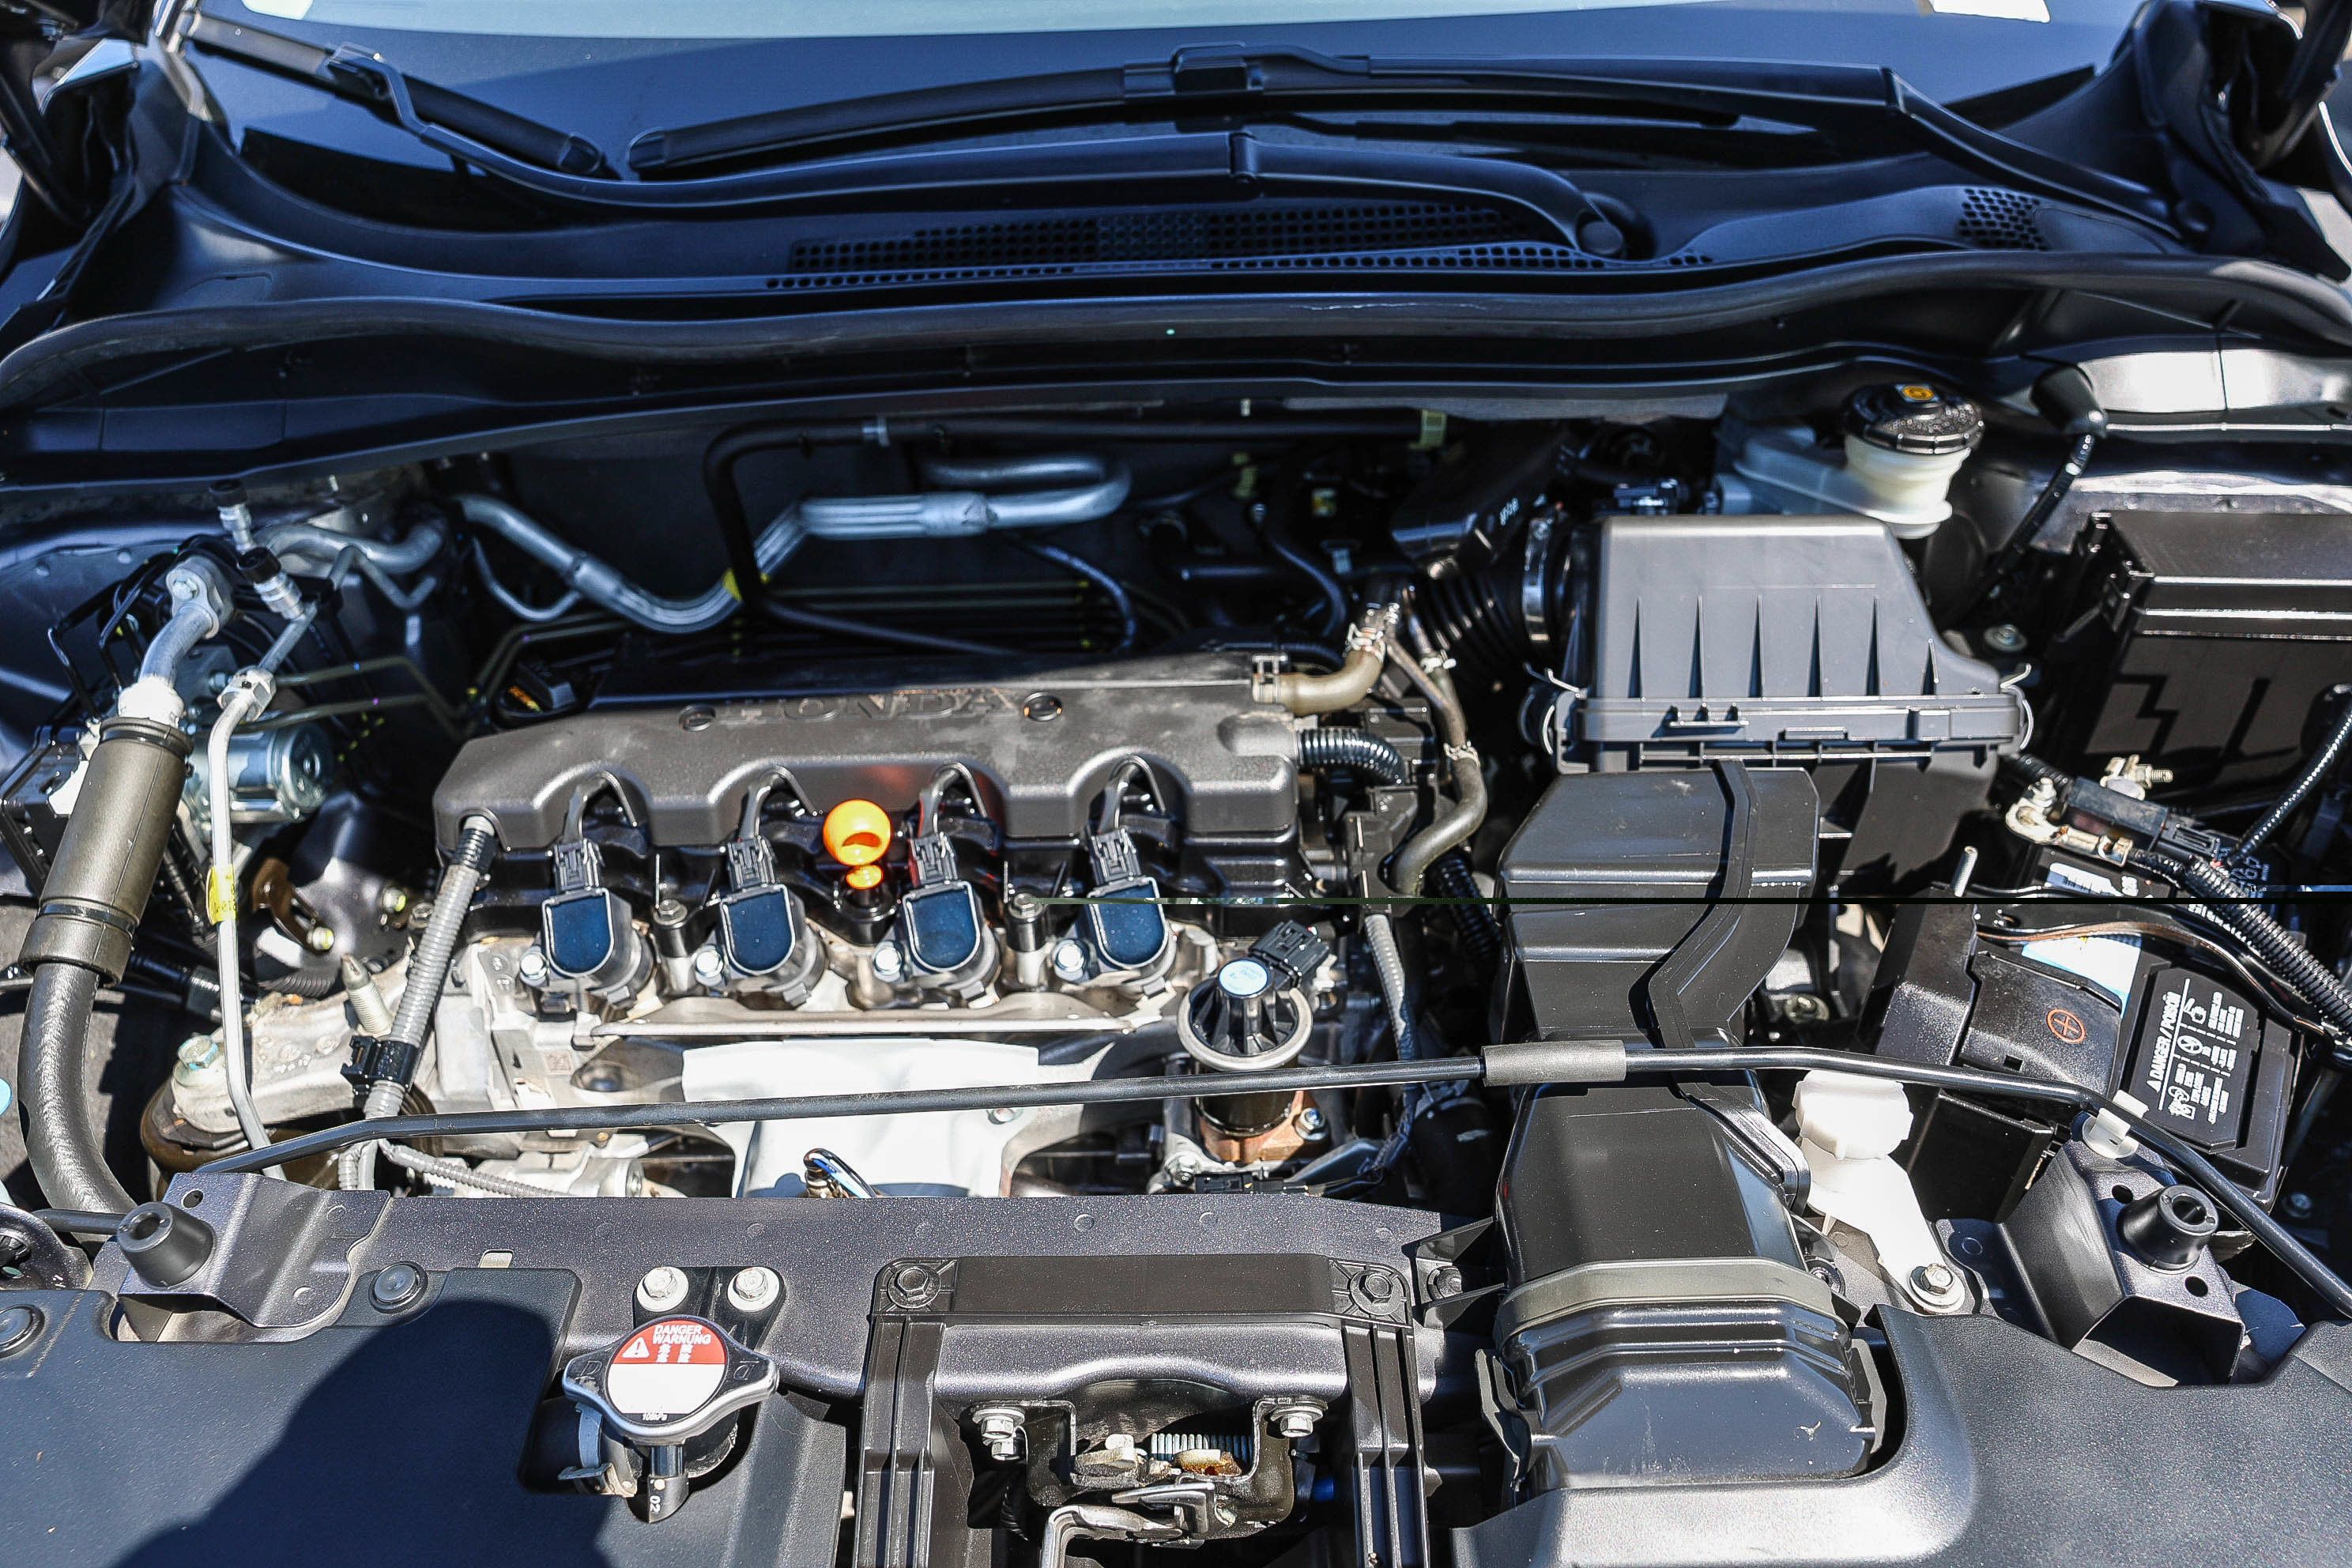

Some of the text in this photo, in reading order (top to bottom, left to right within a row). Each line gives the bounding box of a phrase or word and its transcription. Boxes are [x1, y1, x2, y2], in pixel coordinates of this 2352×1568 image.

[718, 686, 1020, 724] HONDA
[654, 1325, 703, 1335] DANGER
[653, 1333, 711, 1345] WARNUNG
